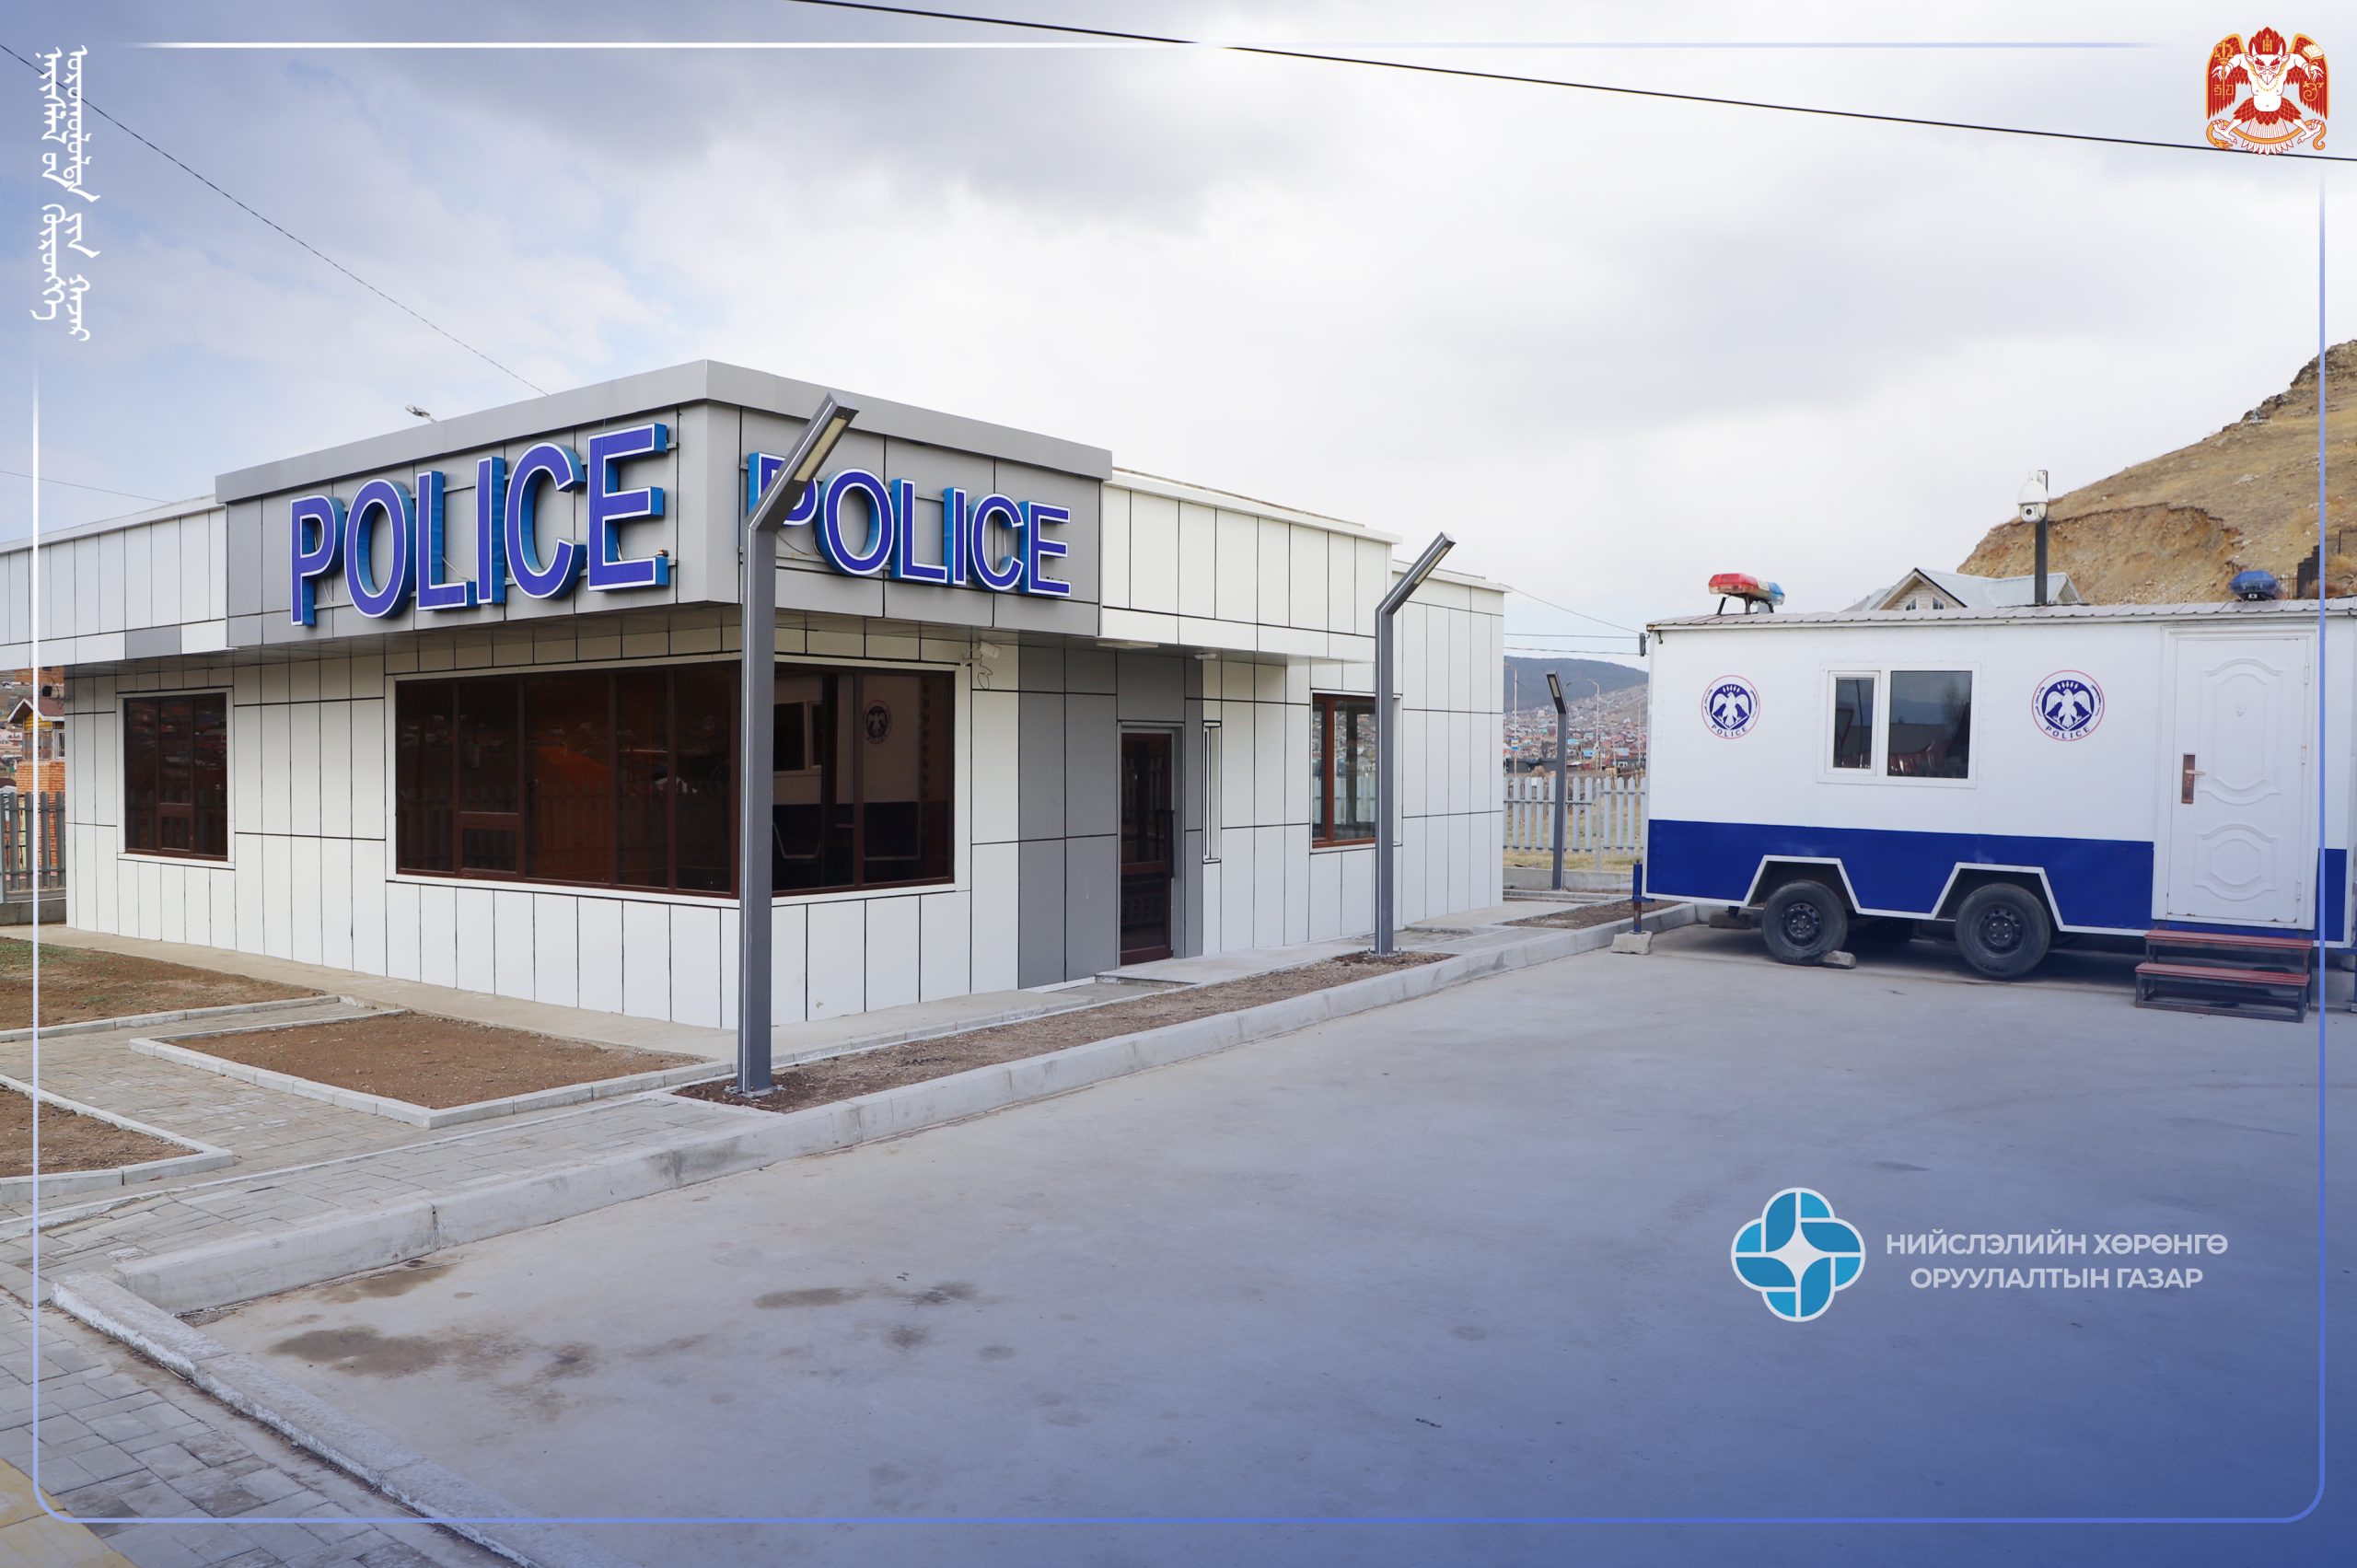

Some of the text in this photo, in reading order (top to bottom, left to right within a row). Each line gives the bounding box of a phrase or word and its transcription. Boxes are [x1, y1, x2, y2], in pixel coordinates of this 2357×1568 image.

[290, 422, 669, 626] POLICE
[1712, 724, 1747, 738] POLICE
[2045, 725, 2090, 739] POLICE
